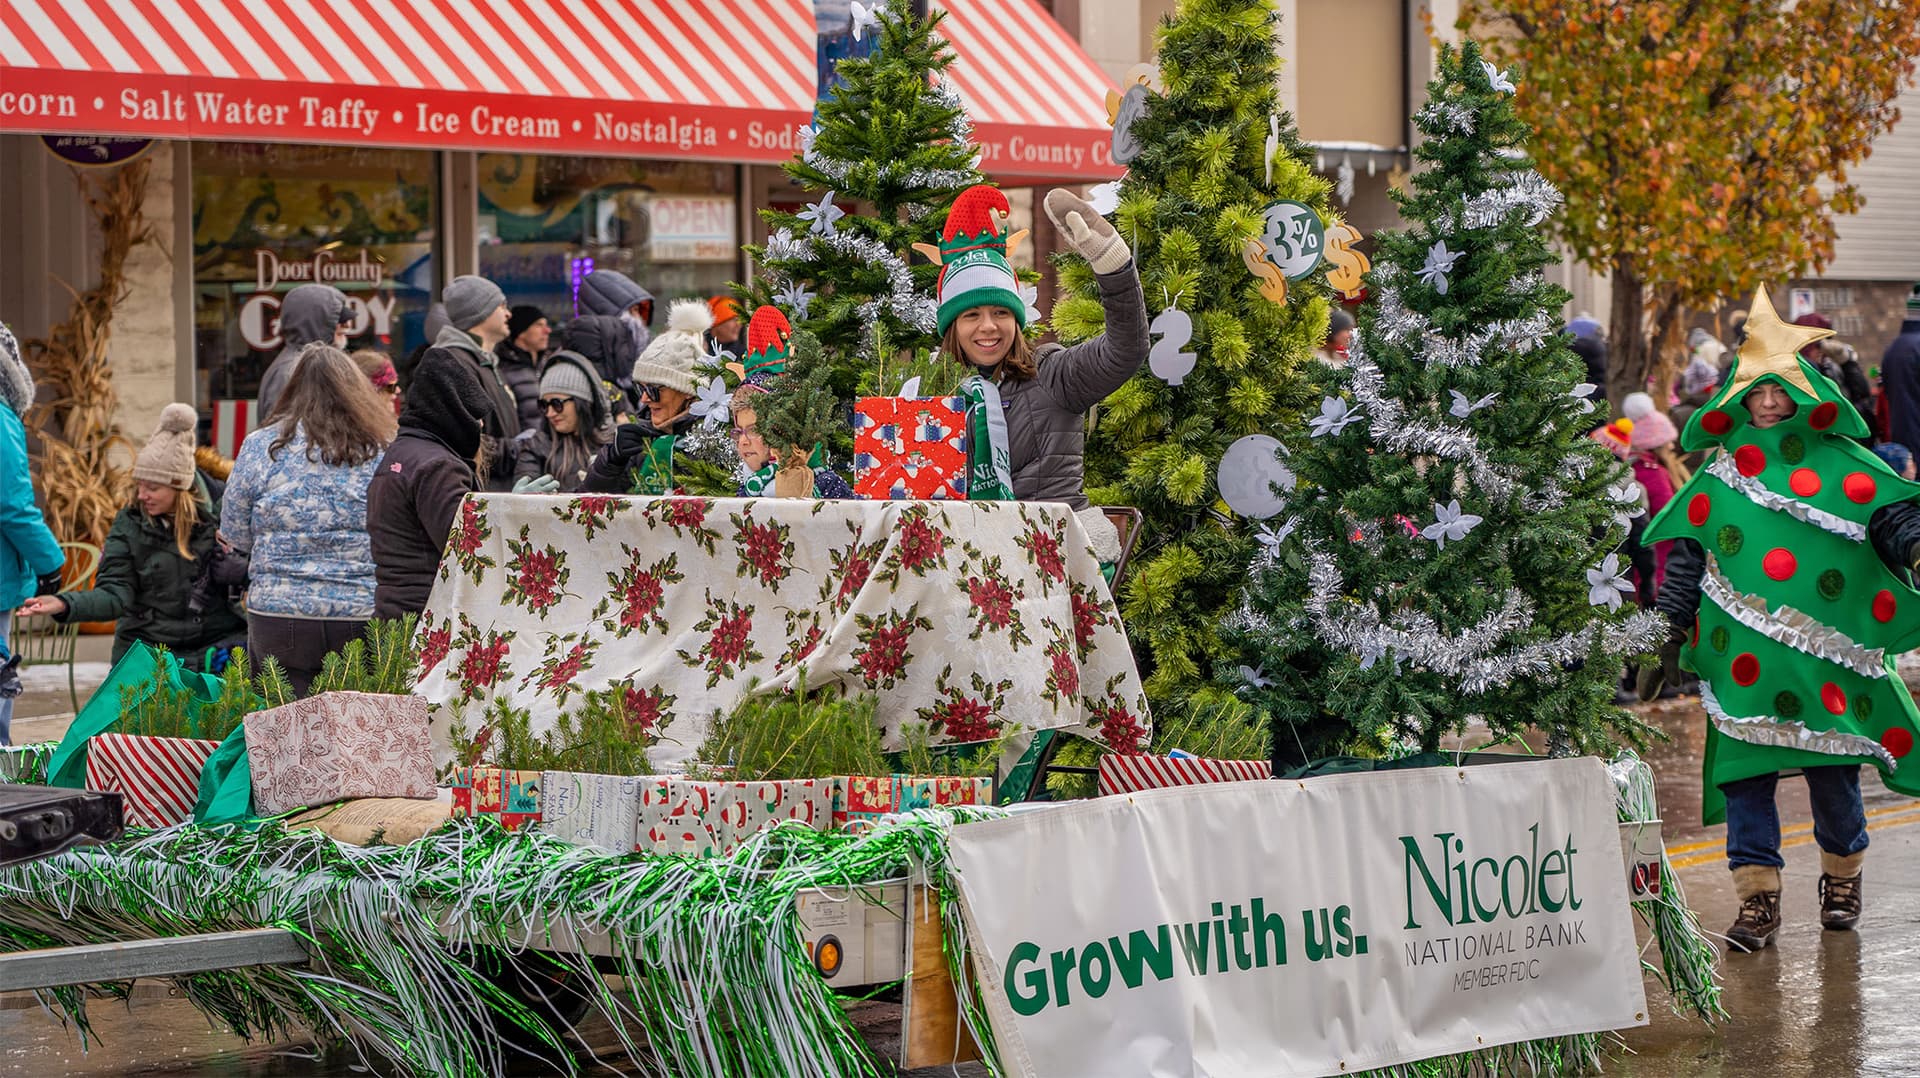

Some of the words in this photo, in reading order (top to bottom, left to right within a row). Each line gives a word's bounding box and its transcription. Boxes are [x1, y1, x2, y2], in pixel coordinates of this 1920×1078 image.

[0, 91, 77, 117] corn
[120, 88, 187, 122] Salt
[194, 92, 290, 126] Water
[300, 96, 380, 135] Taffy
[416, 102, 460, 134] Ice
[470, 105, 561, 139] Cream
[593, 112, 717, 151] Nostalgia
[979, 141, 1003, 161] or
[1009, 135, 1086, 169] County
[655, 200, 727, 233] OPEN
[256, 250, 313, 291] Door
[314, 249, 383, 288] County
[1398, 821, 1583, 930] Nicolet
[1003, 922, 1174, 1017] Grow
[1172, 897, 1288, 977] with
[1301, 904, 1369, 962] us.
[1404, 929, 1516, 967] NATIONAL
[1524, 918, 1587, 951] BANK
[1453, 963, 1509, 993] MEMBER
[1509, 958, 1541, 983] FDIC
